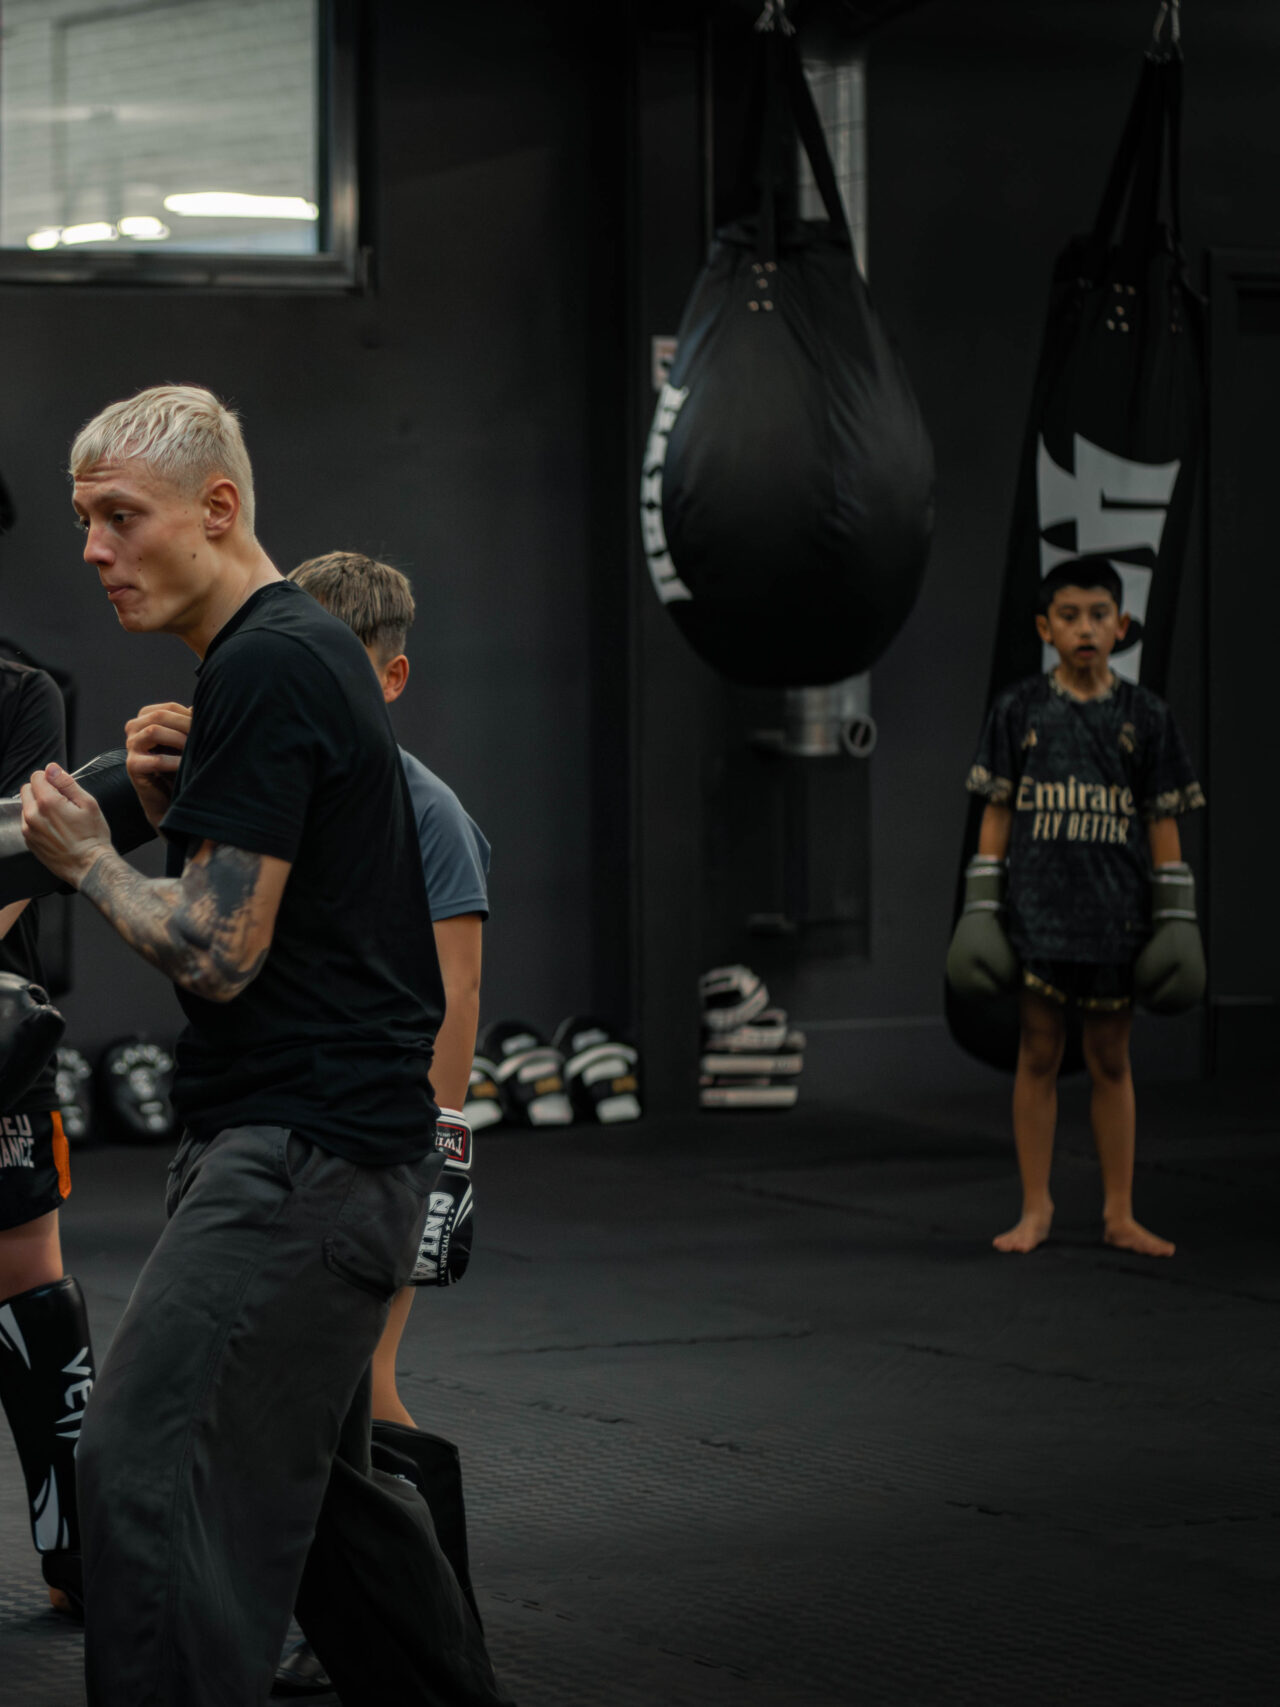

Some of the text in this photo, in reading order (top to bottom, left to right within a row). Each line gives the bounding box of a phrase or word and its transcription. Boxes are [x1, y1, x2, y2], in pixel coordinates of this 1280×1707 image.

[435, 1136, 463, 1157] TWI
[439, 1233, 451, 1269] SPECIAL
[55, 1346, 96, 1440] VEN
